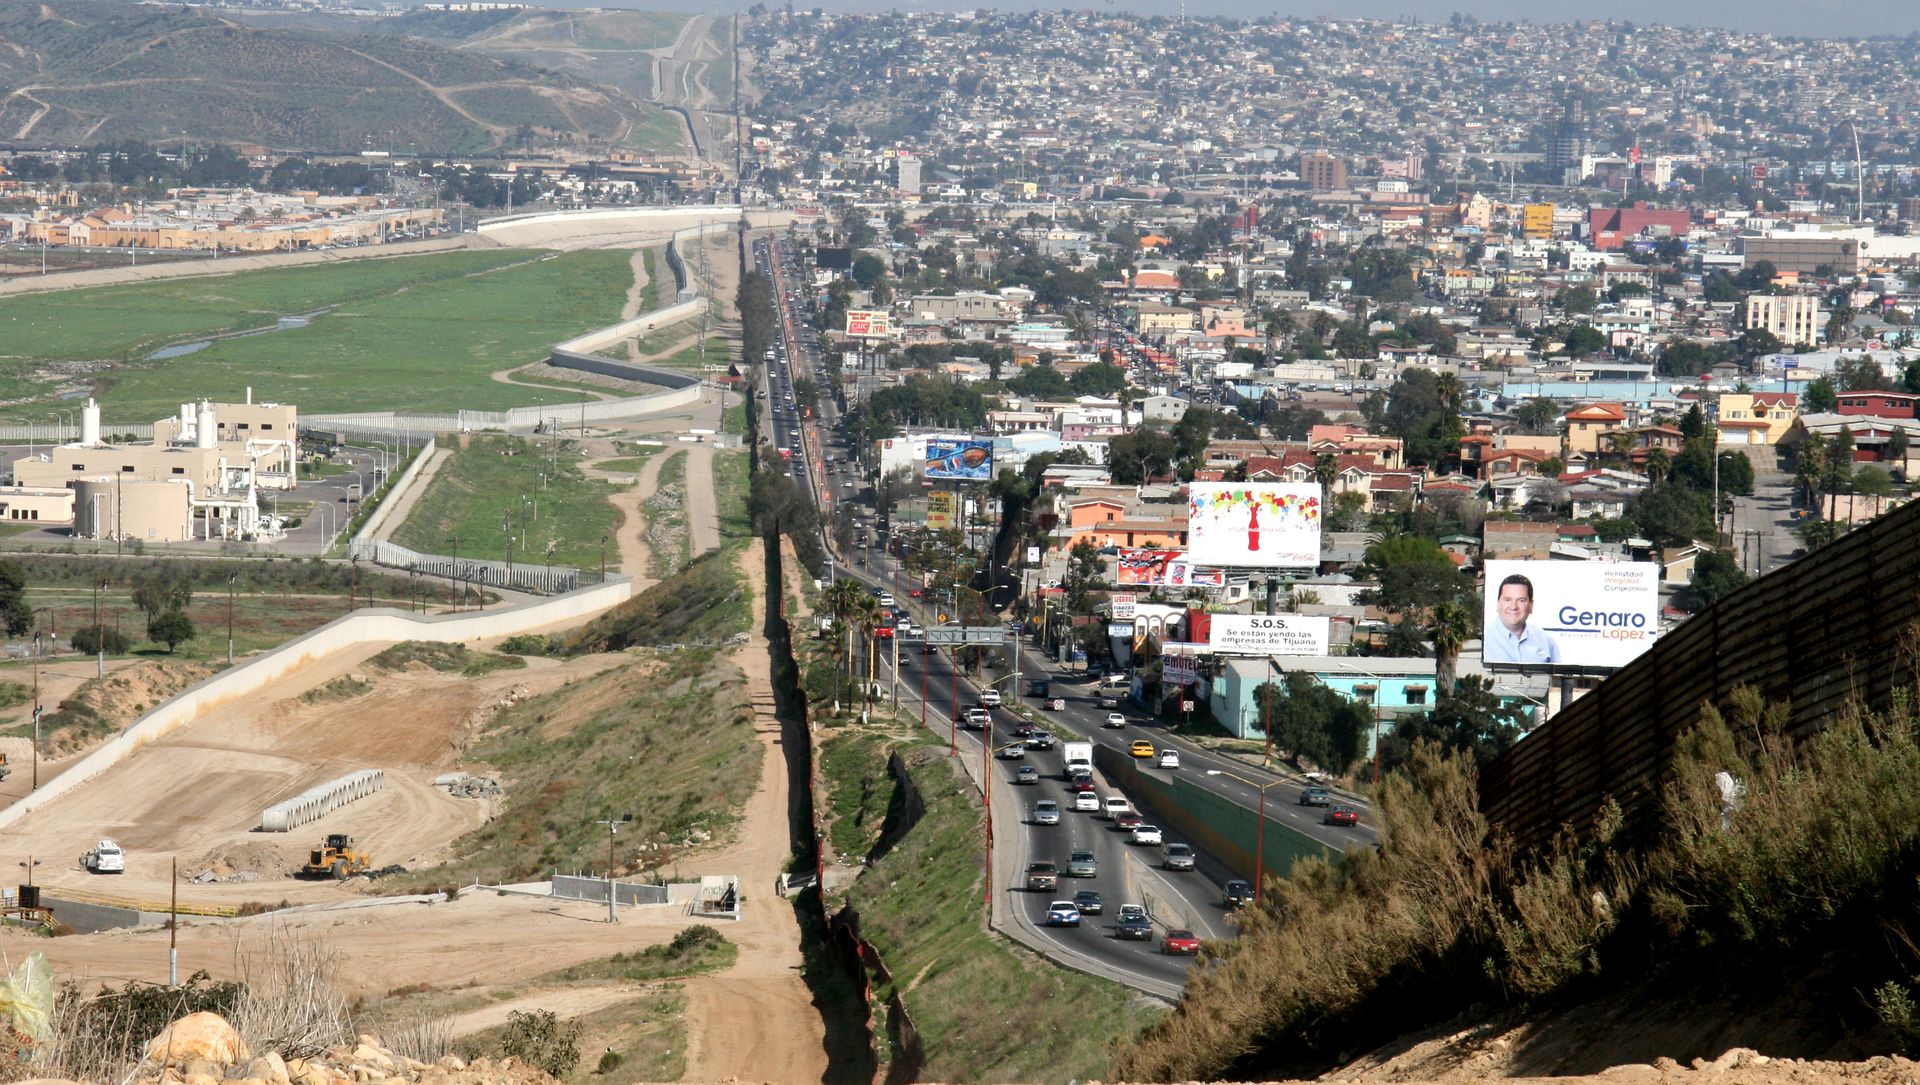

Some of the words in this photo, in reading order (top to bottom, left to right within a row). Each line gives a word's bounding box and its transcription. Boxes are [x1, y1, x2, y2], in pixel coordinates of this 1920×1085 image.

[1603, 585, 1648, 593] Compromiso
[1558, 605, 1646, 628] Genaro
[1250, 618, 1289, 629] S.O.S.
[1226, 628, 1238, 636] Se
[1240, 629, 1266, 637] están
[1268, 630, 1296, 639] yendo
[1602, 628, 1646, 642] López
[1221, 637, 1267, 646] empresas
[1268, 637, 1280, 645] de
[1283, 637, 1317, 647] Tijuana
[1170, 656, 1198, 671] MOTEL
